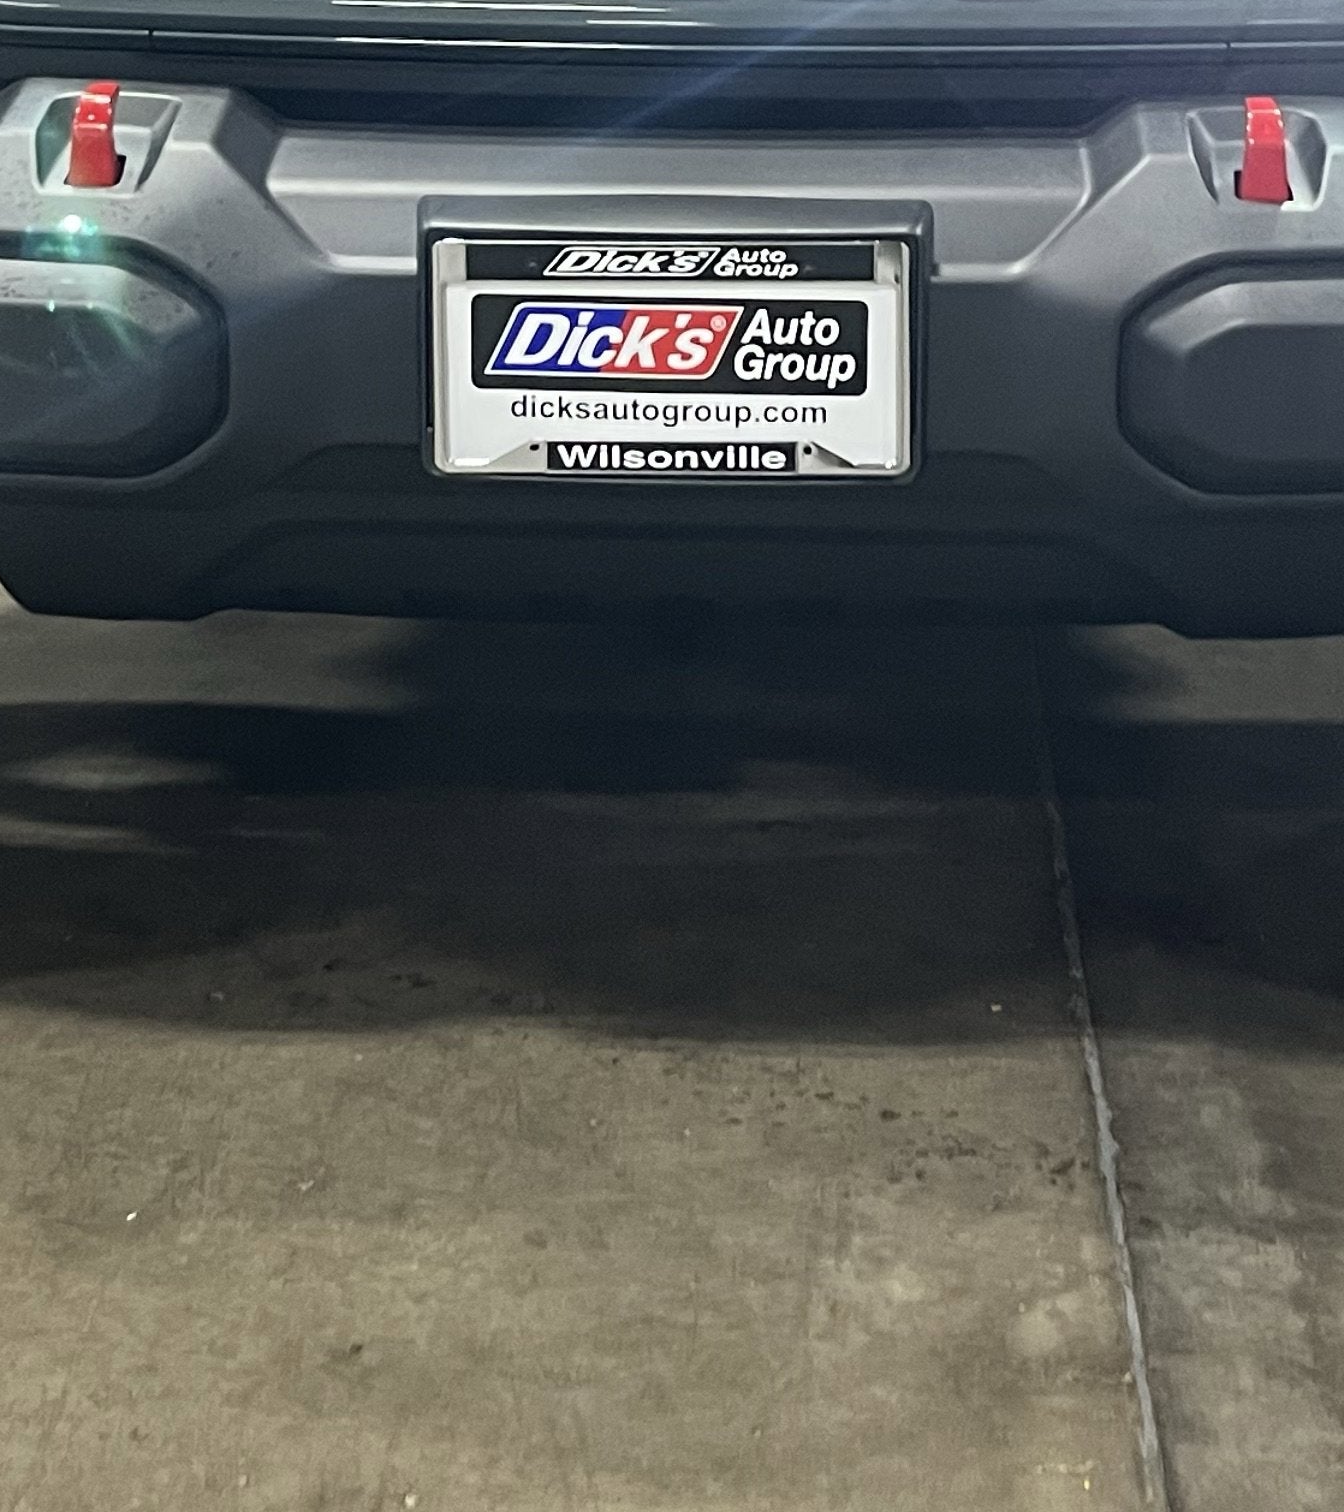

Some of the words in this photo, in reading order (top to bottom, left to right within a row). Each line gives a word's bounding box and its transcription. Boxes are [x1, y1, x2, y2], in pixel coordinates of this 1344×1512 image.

[713, 262, 799, 279] Group
[721, 248, 787, 263] Auto
[741, 308, 840, 346] Auto
[733, 344, 857, 389] Group
[510, 394, 828, 428] dicksautogroup.com
[556, 443, 787, 470] Wilsonville
